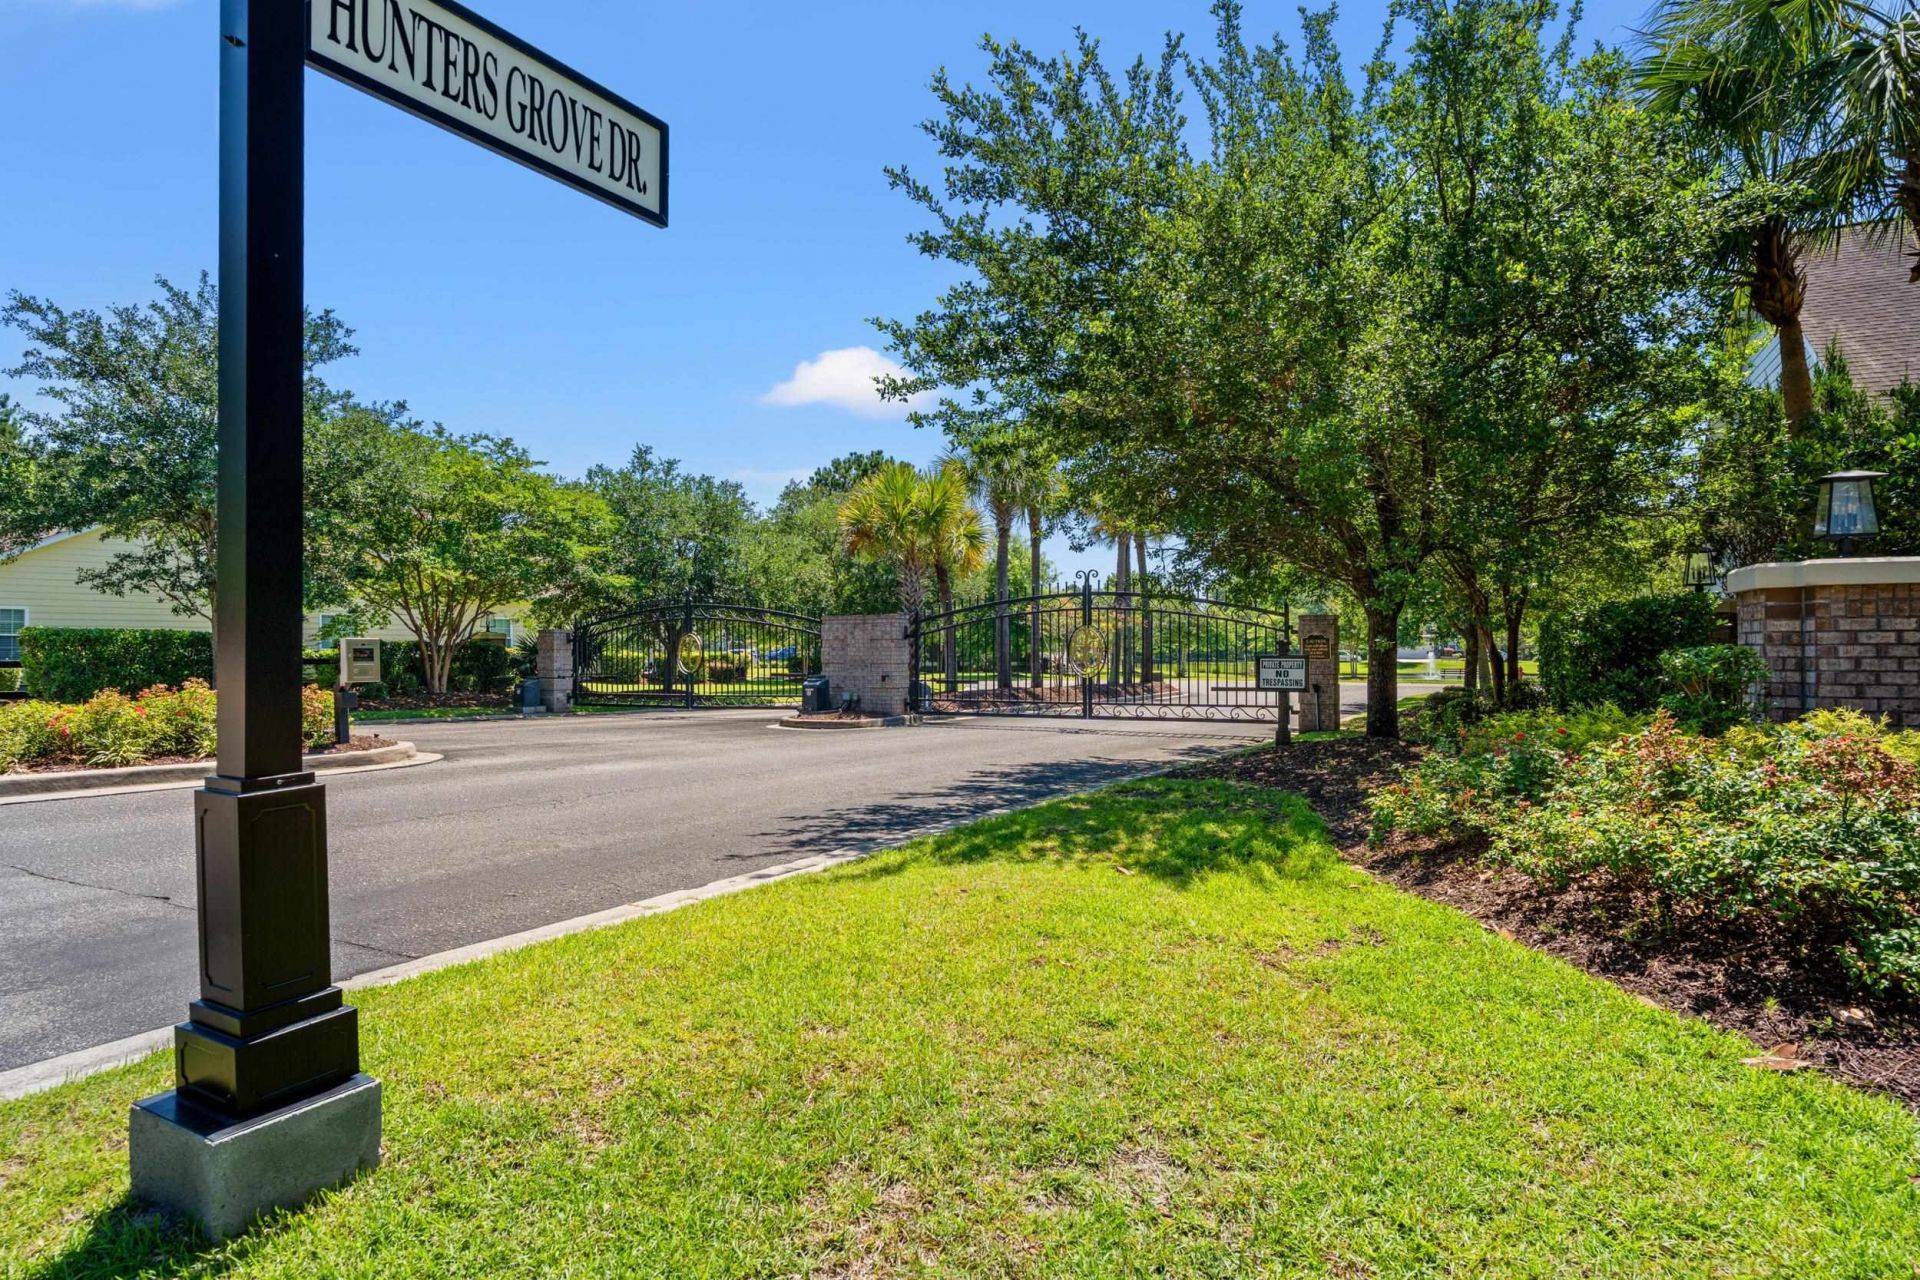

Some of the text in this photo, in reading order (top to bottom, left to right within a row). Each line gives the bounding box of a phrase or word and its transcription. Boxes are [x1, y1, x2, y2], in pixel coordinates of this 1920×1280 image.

[506, 66, 602, 173] GROVE
[608, 118, 647, 195] DR.
[1263, 661, 1303, 669] PRIVATE PROPERTY
